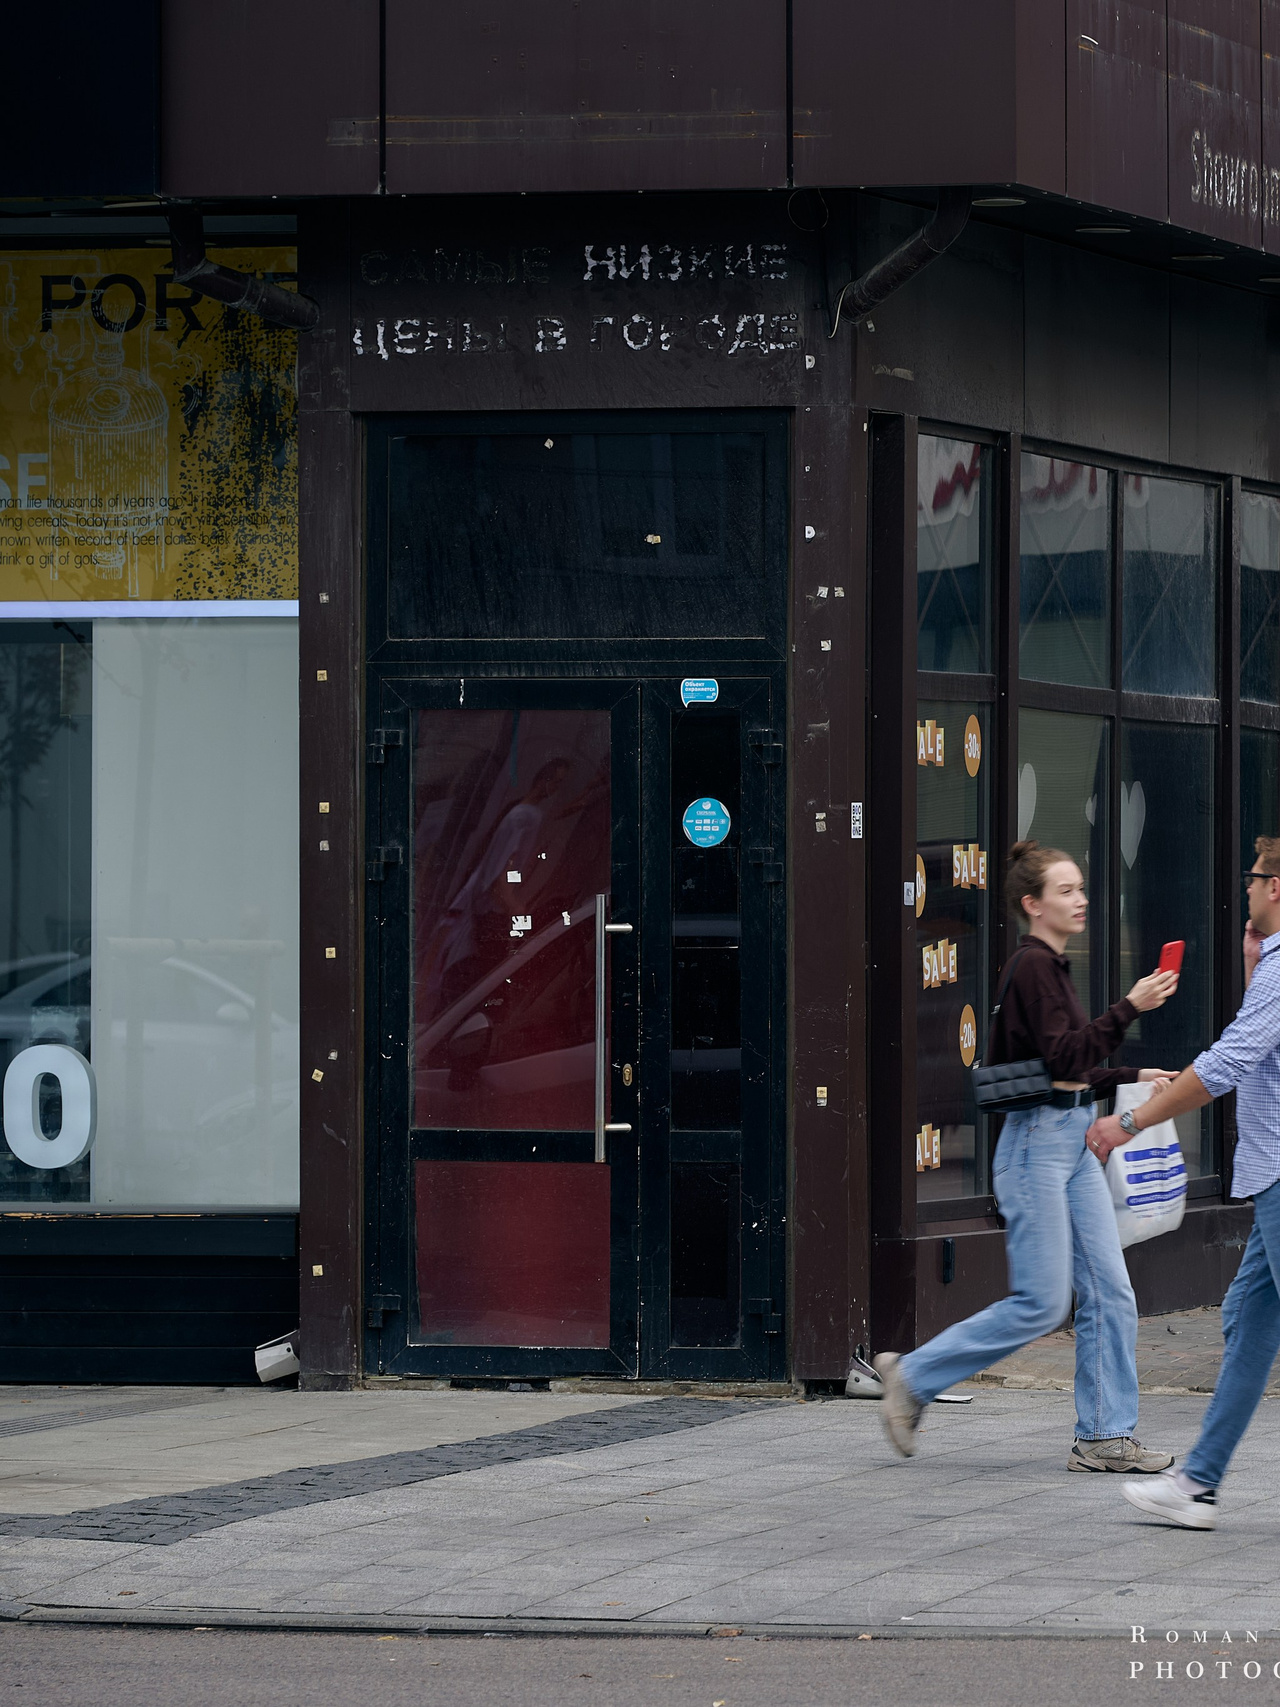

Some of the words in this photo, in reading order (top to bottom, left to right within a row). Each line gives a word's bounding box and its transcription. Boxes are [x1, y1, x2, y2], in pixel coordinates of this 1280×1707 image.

[359, 246, 551, 284] САМЫЕ
[583, 243, 788, 282] НИЗКИЕ
[352, 316, 508, 361] ЦЕНЫ
[590, 311, 799, 358] ГОРОДЕ
[27, 494, 42, 508] life
[47, 494, 103, 508] thousands
[108, 494, 119, 508] of
[123, 497, 154, 511] years
[75, 514, 109, 529] Today
[133, 515, 151, 527] not
[155, 513, 192, 527] known
[75, 532, 111, 547] record
[116, 532, 128, 547] of
[133, 532, 158, 546] beer
[26, 555, 34, 565] a
[59, 551, 69, 565] of
[953, 850, 985, 885] SALE
[923, 946, 955, 982] SALE
[960, 1022, 976, 1048] -20%
